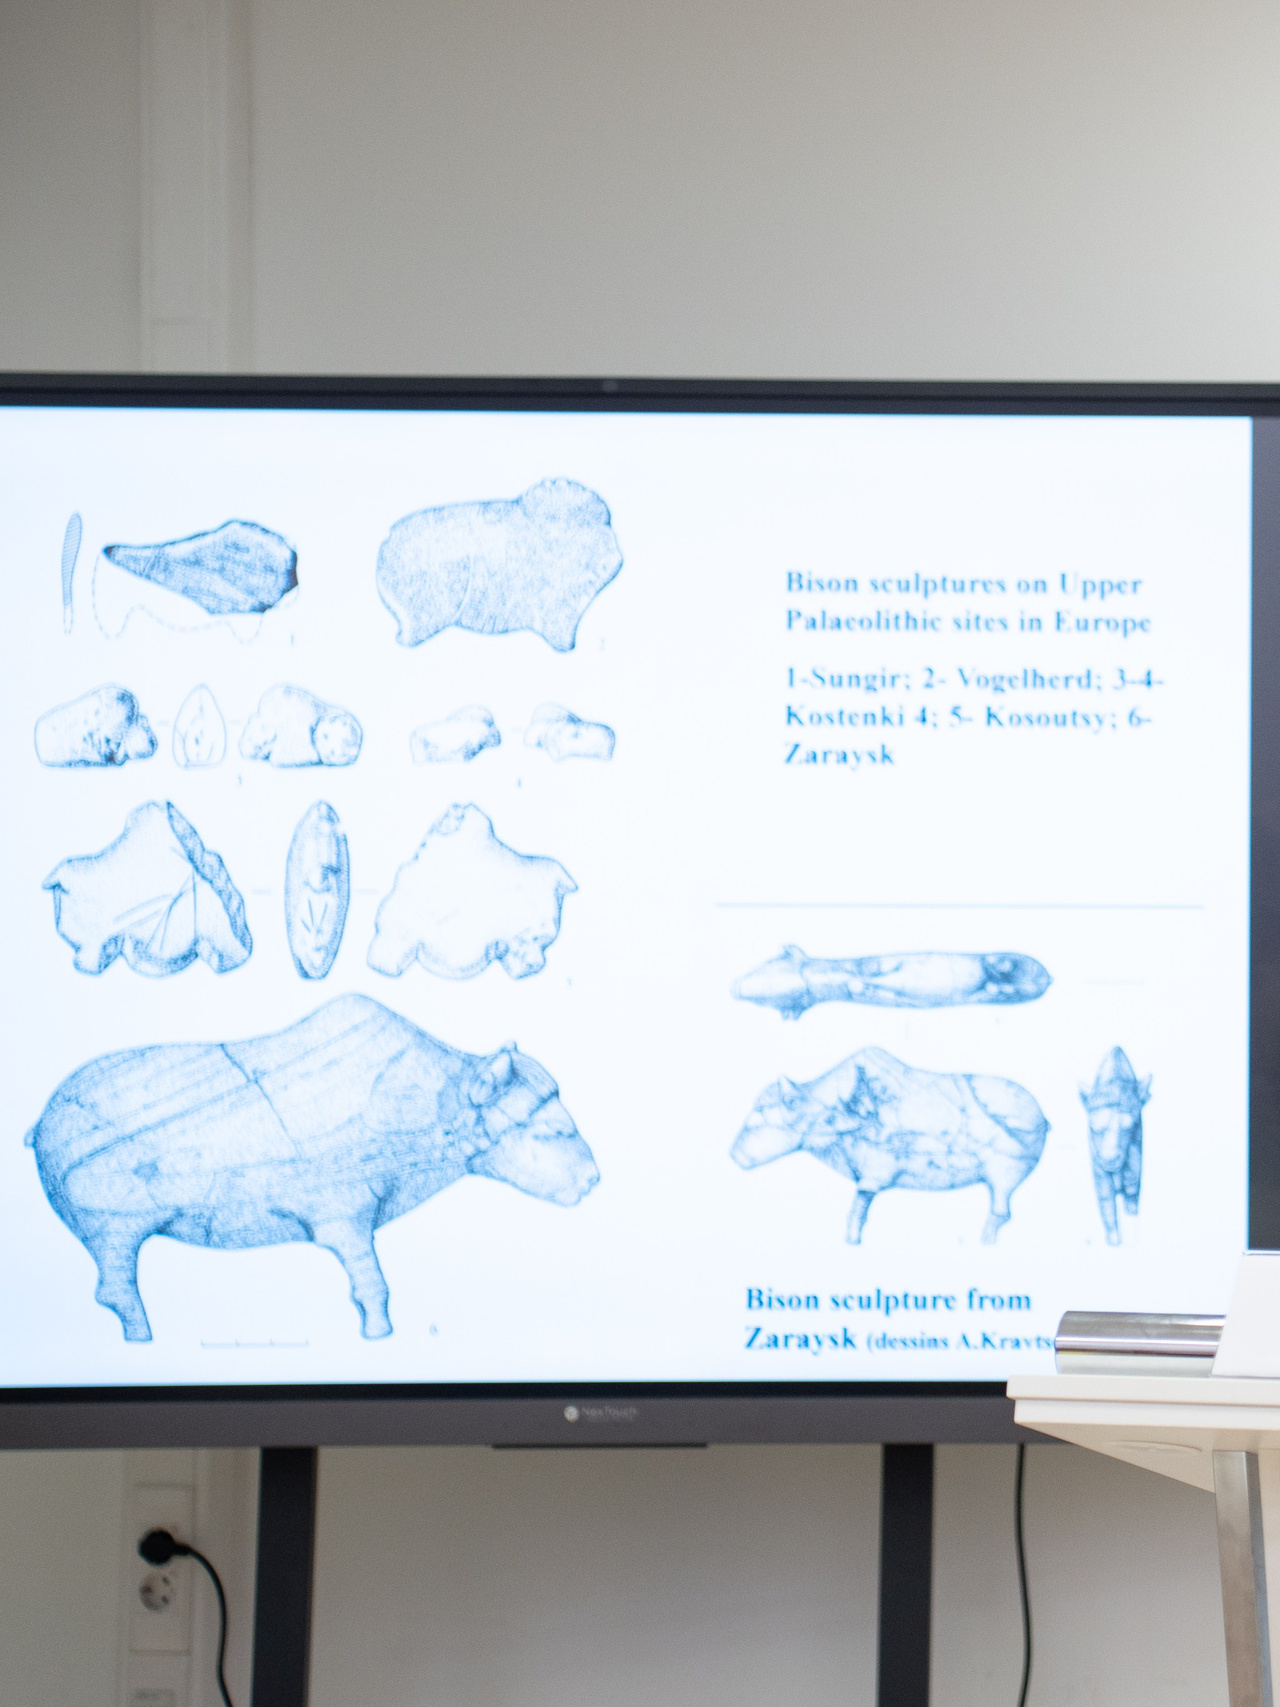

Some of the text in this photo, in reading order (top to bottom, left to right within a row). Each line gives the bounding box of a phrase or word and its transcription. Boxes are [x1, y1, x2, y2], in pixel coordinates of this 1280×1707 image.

[785, 570, 1145, 602] Bison sculptures on Upper
[785, 608, 1152, 640] Palaeolithic sites in Europe
[786, 665, 911, 694] 1-Sungir;
[922, 666, 946, 690] 2-
[956, 666, 1102, 694] Vogelherd;
[785, 703, 1153, 734] Kostenki 4; 5- Kosoutsy; 6-
[783, 741, 895, 771] Zaraysk
[745, 1286, 1033, 1317] Bison sculpture from
[744, 1326, 1056, 1356] Zaraysk (dessins A.Kravts
